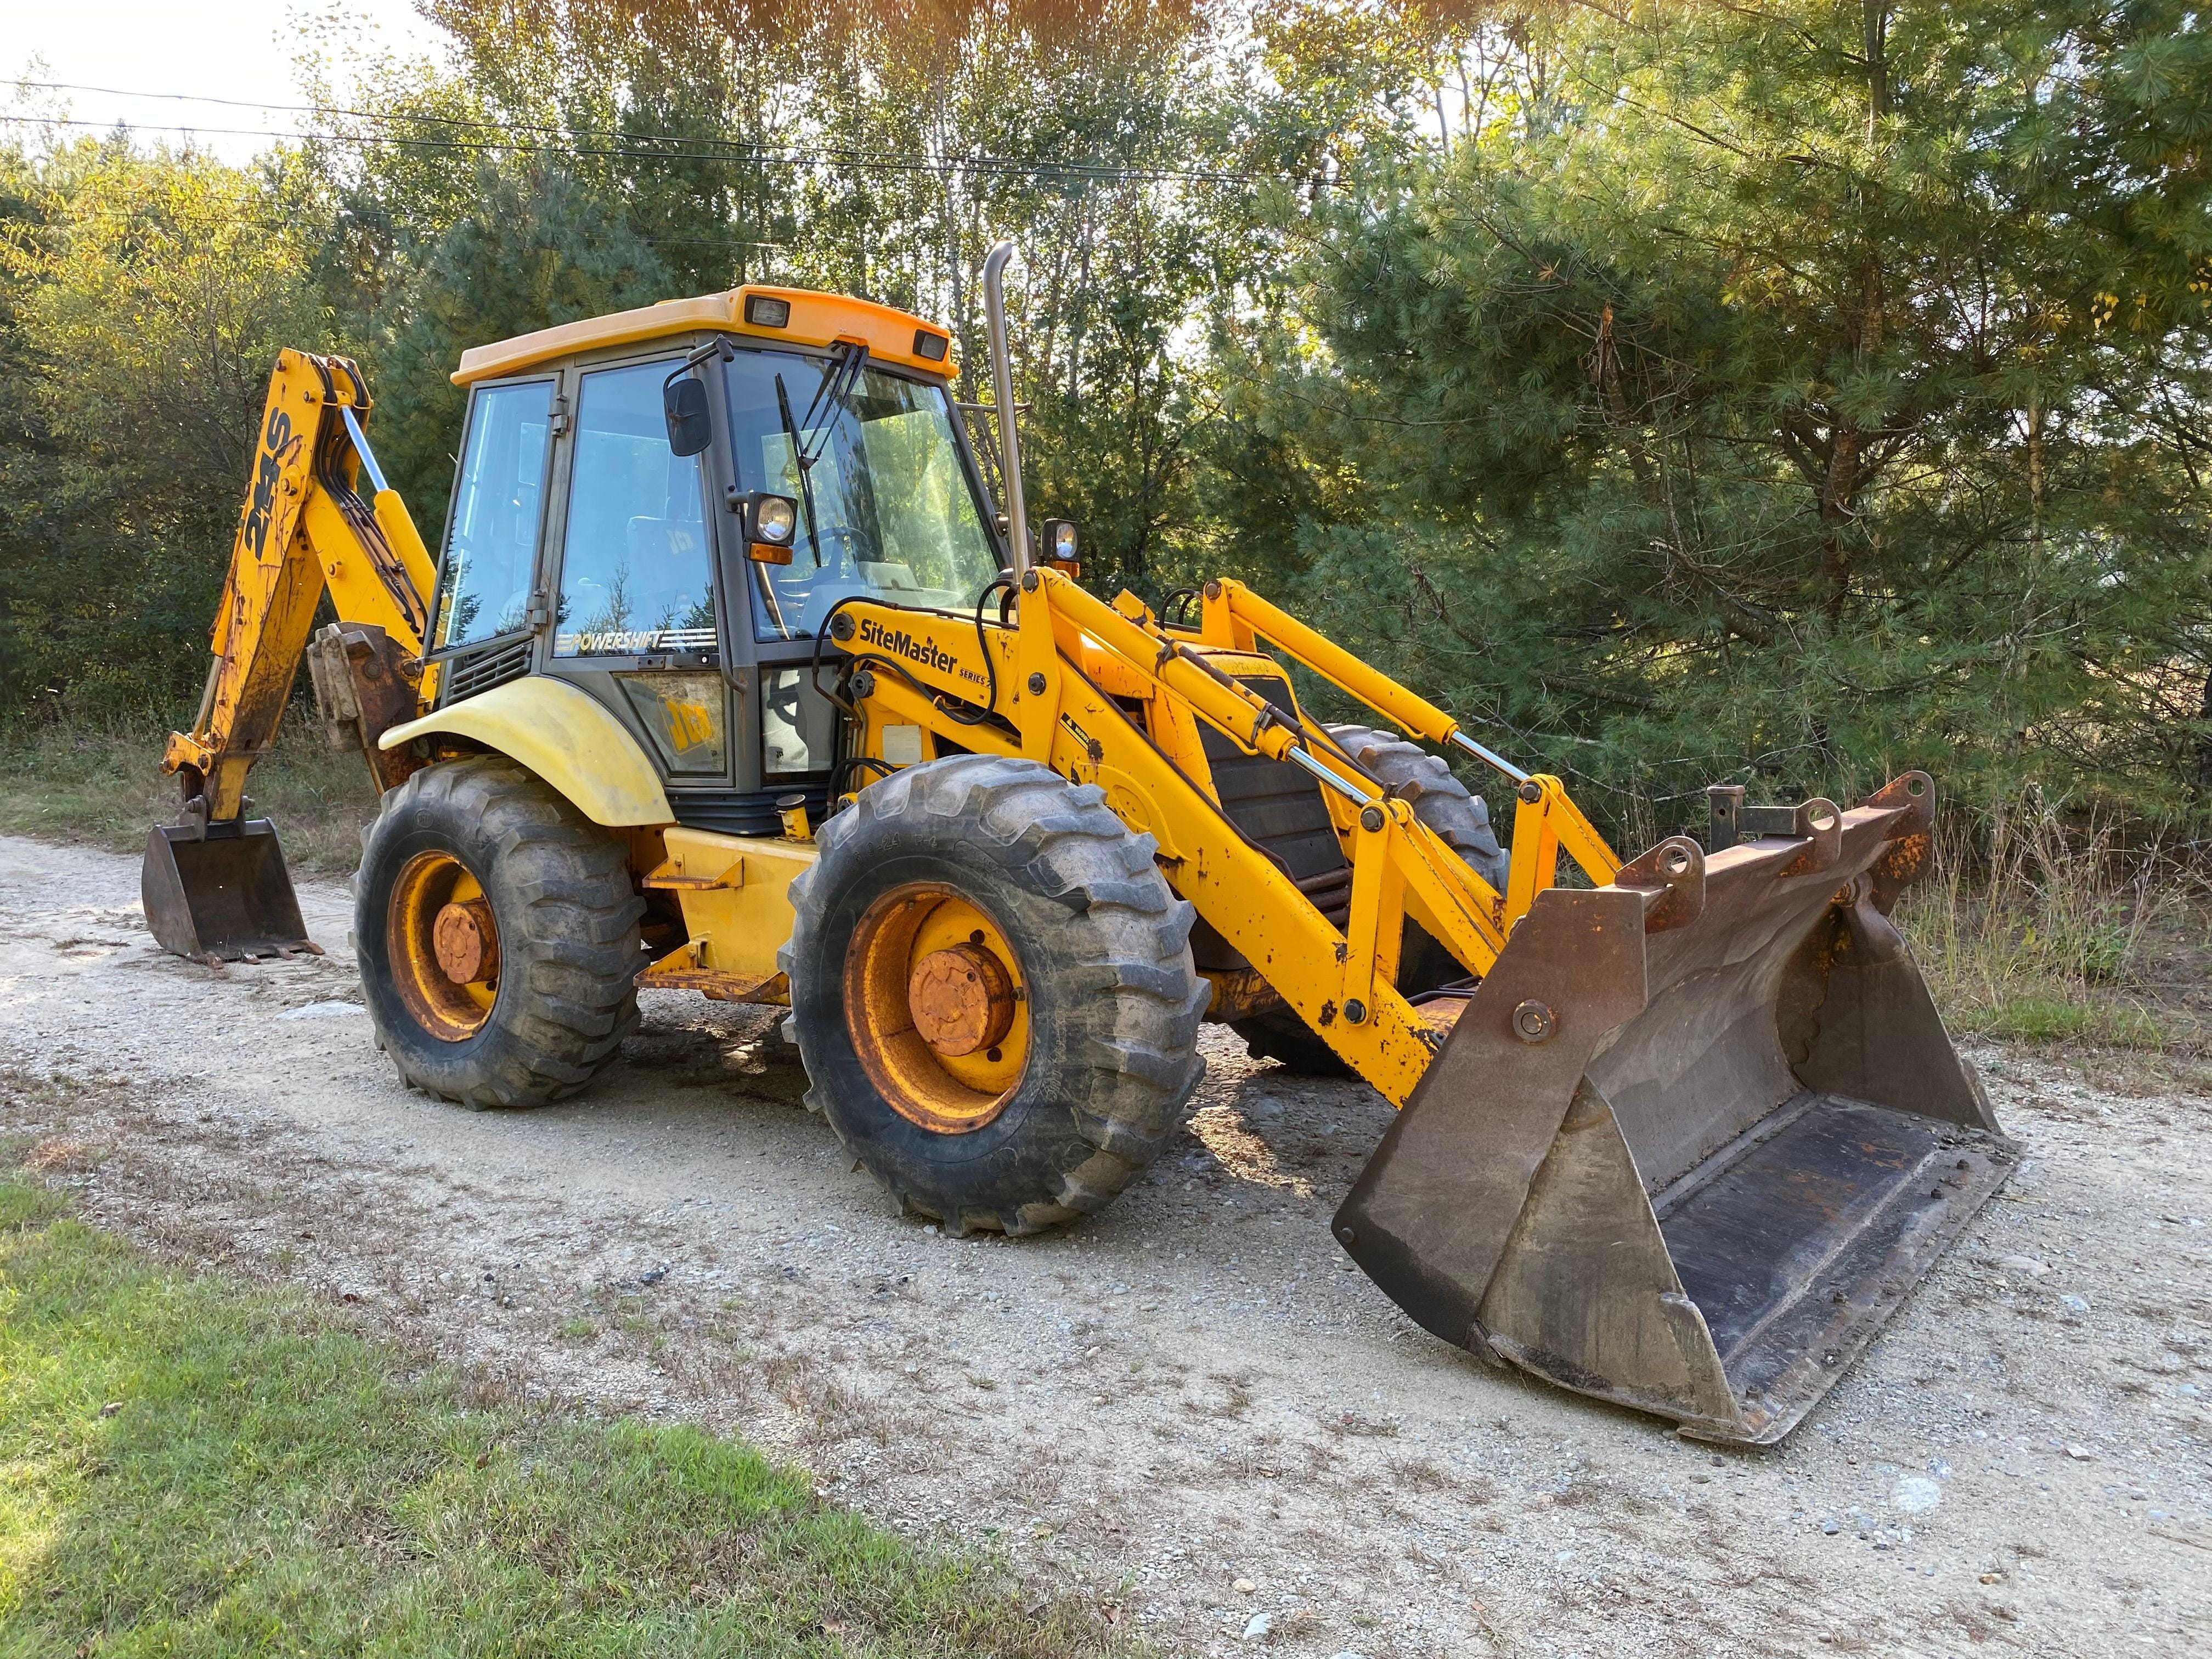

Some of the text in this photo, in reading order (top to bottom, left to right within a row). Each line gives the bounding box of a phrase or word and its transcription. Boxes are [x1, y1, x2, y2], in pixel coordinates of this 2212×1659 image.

[569, 631, 664, 651] POWERSHIFT
[860, 618, 958, 674] SiteMaster
[960, 669, 985, 685] SERIES
